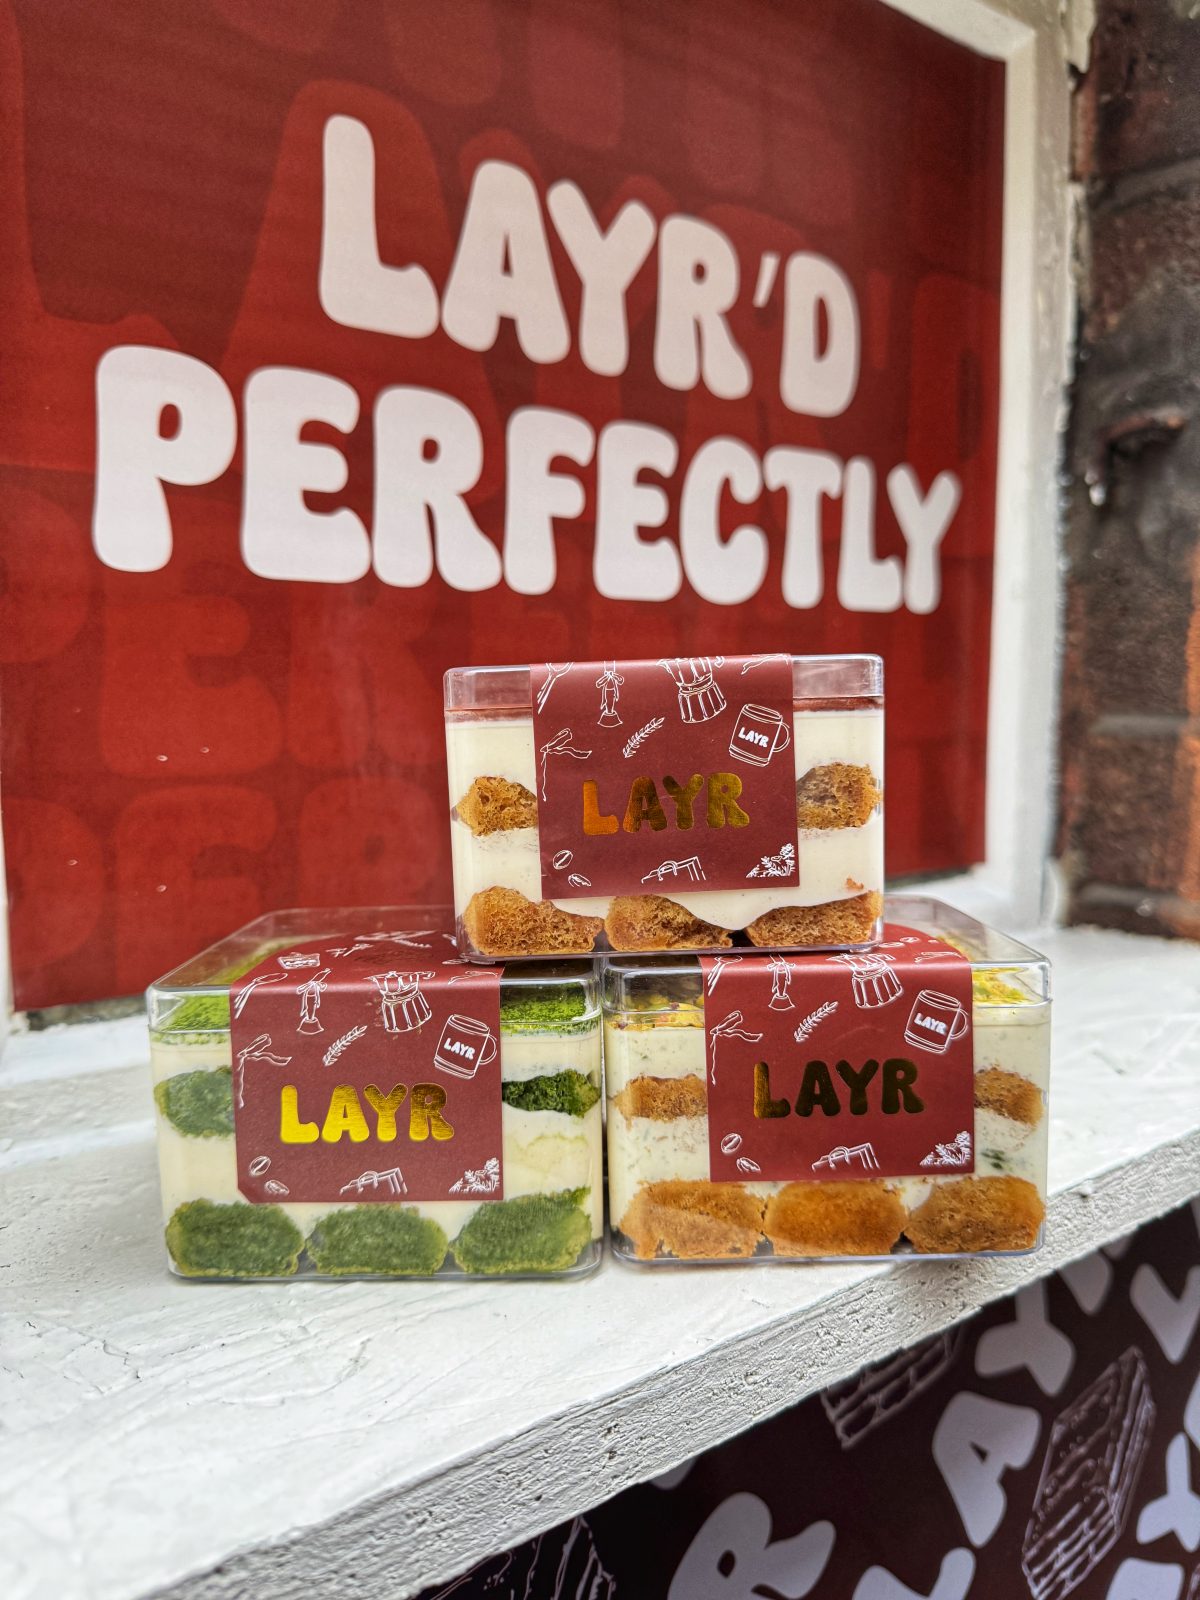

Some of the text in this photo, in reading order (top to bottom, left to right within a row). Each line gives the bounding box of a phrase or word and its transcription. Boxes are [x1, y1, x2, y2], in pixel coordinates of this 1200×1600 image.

[320, 114, 857, 416] LAYR'D
[92, 345, 961, 613] PERFECTLY
[738, 727, 769, 748] LAYR
[581, 772, 751, 837] LAYR
[443, 1037, 476, 1060] LAYR
[913, 1013, 947, 1036] LAYR
[279, 1083, 455, 1145] LAYR
[753, 1057, 925, 1119] LAYR
